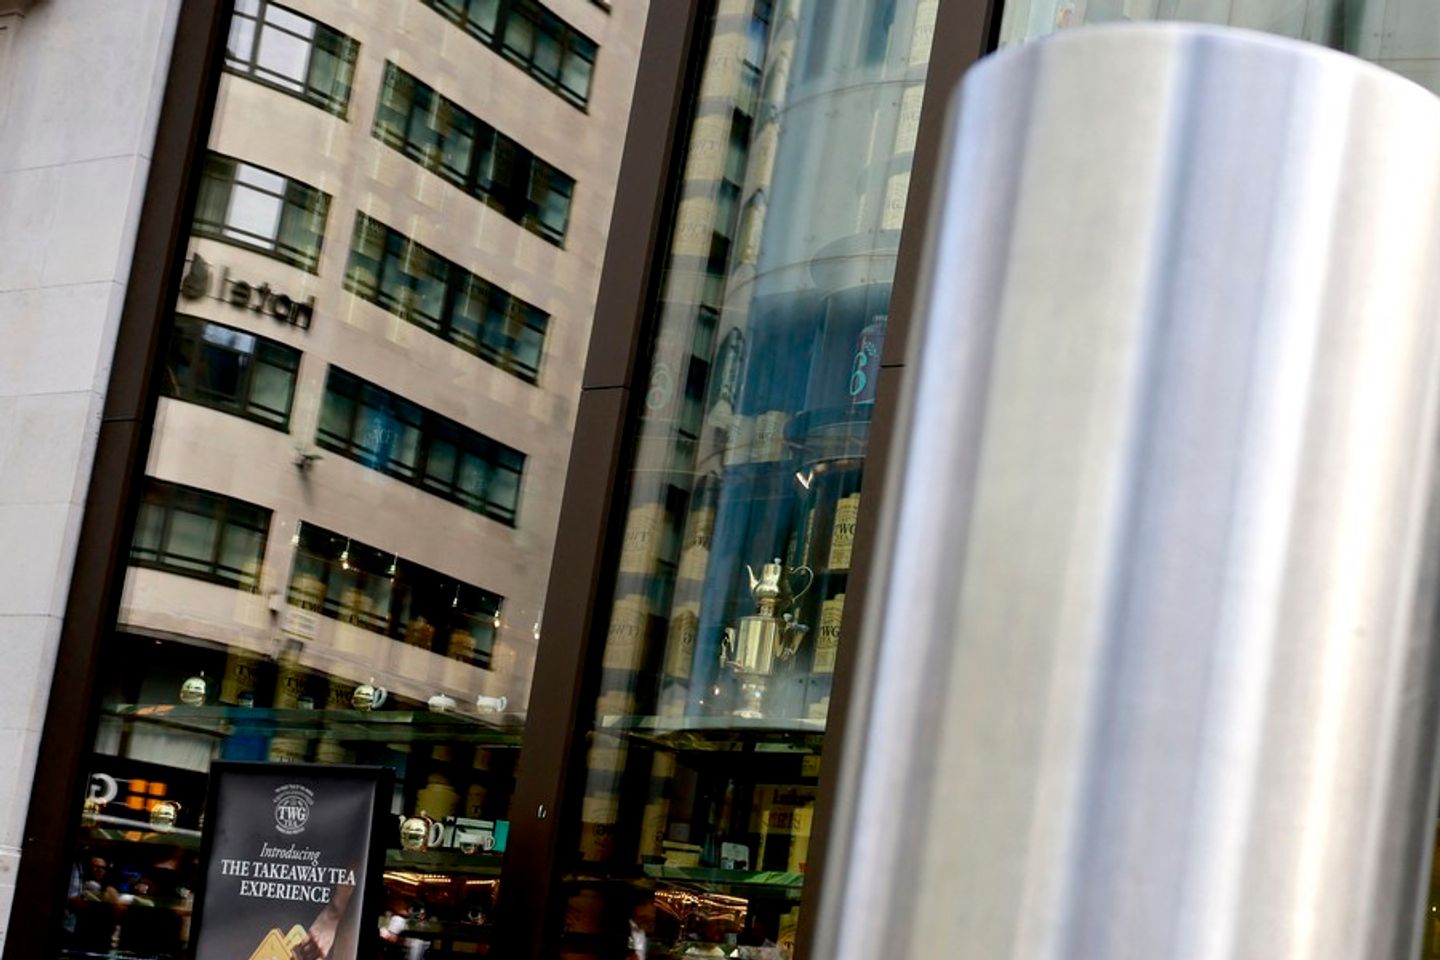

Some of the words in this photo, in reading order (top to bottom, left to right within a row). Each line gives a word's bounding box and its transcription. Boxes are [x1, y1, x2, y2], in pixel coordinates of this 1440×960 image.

[279, 805, 307, 822] TWG
[284, 820, 299, 828] TEA
[259, 842, 322, 867] Introducing
[221, 859, 251, 877] THE
[252, 862, 328, 884] TAKEAWAY
[328, 867, 357, 887] TEA
[239, 879, 332, 905] EXPERIENCE
